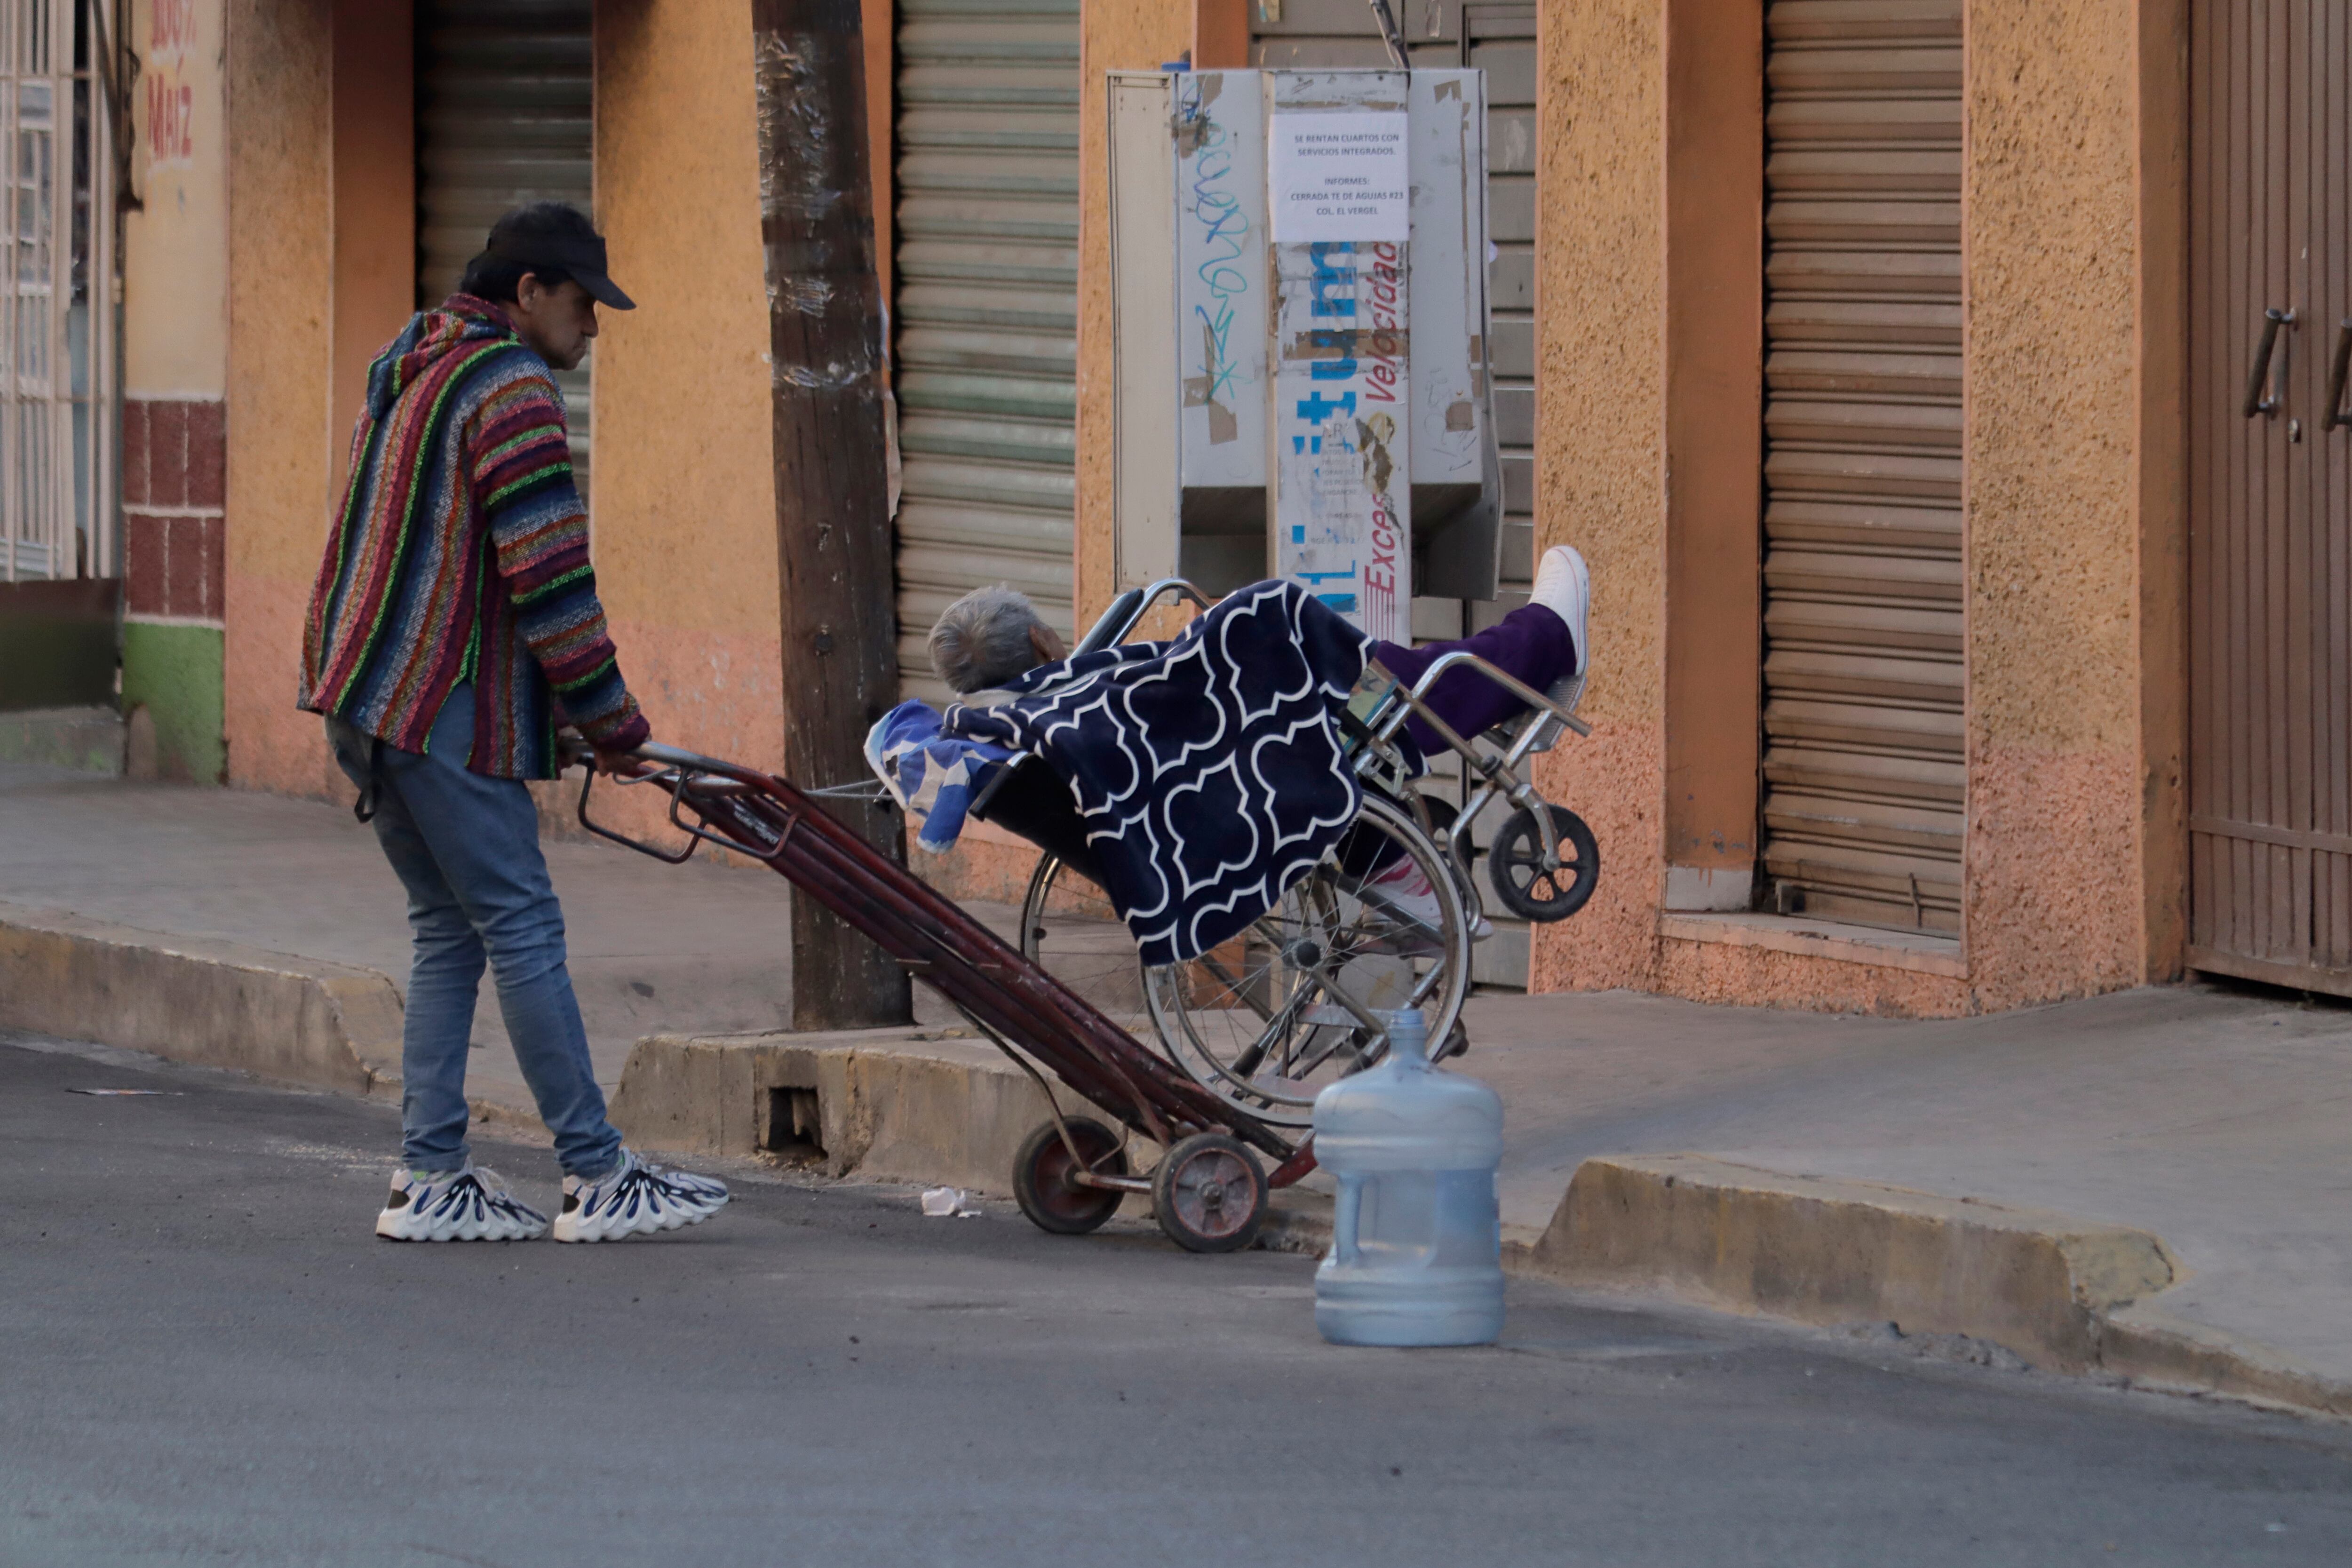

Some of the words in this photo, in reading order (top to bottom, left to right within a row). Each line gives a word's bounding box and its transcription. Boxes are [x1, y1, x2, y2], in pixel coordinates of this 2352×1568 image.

[1295, 135, 1303, 143] SE
[1306, 134, 1340, 143] RENTAN
[1341, 134, 1380, 143] CUARTOS
[1382, 134, 1400, 142] CON
[1298, 148, 1340, 156] SERVICIOS
[1291, 192, 1329, 201] CERRADA
[1343, 192, 1353, 200] DE
[1356, 191, 1388, 200] AGUJAS
[1389, 191, 1404, 199] #23
[1365, 241, 1397, 403] Velocidad
